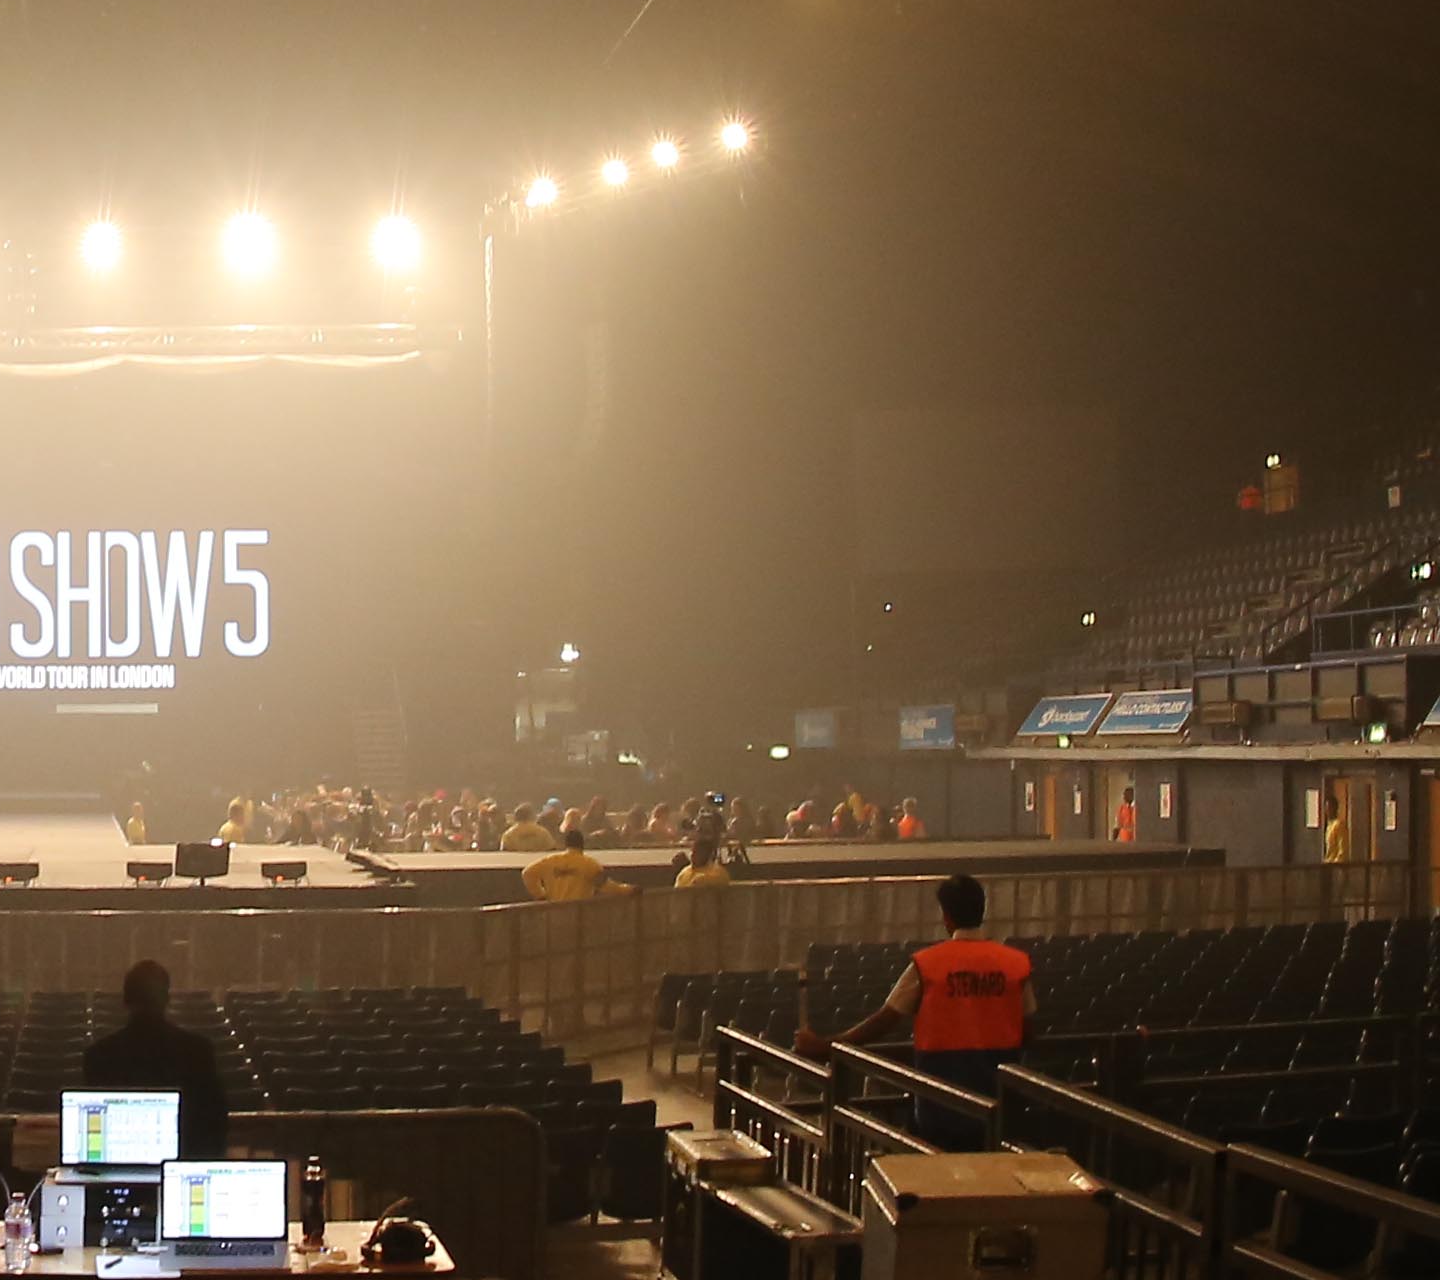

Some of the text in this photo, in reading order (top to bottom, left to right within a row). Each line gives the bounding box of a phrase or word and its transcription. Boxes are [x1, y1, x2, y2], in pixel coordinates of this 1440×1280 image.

[47, 664, 89, 689] TOUR
[90, 664, 109, 689] IN
[110, 664, 176, 689] LONDON
[946, 970, 1008, 998] STEWARD
